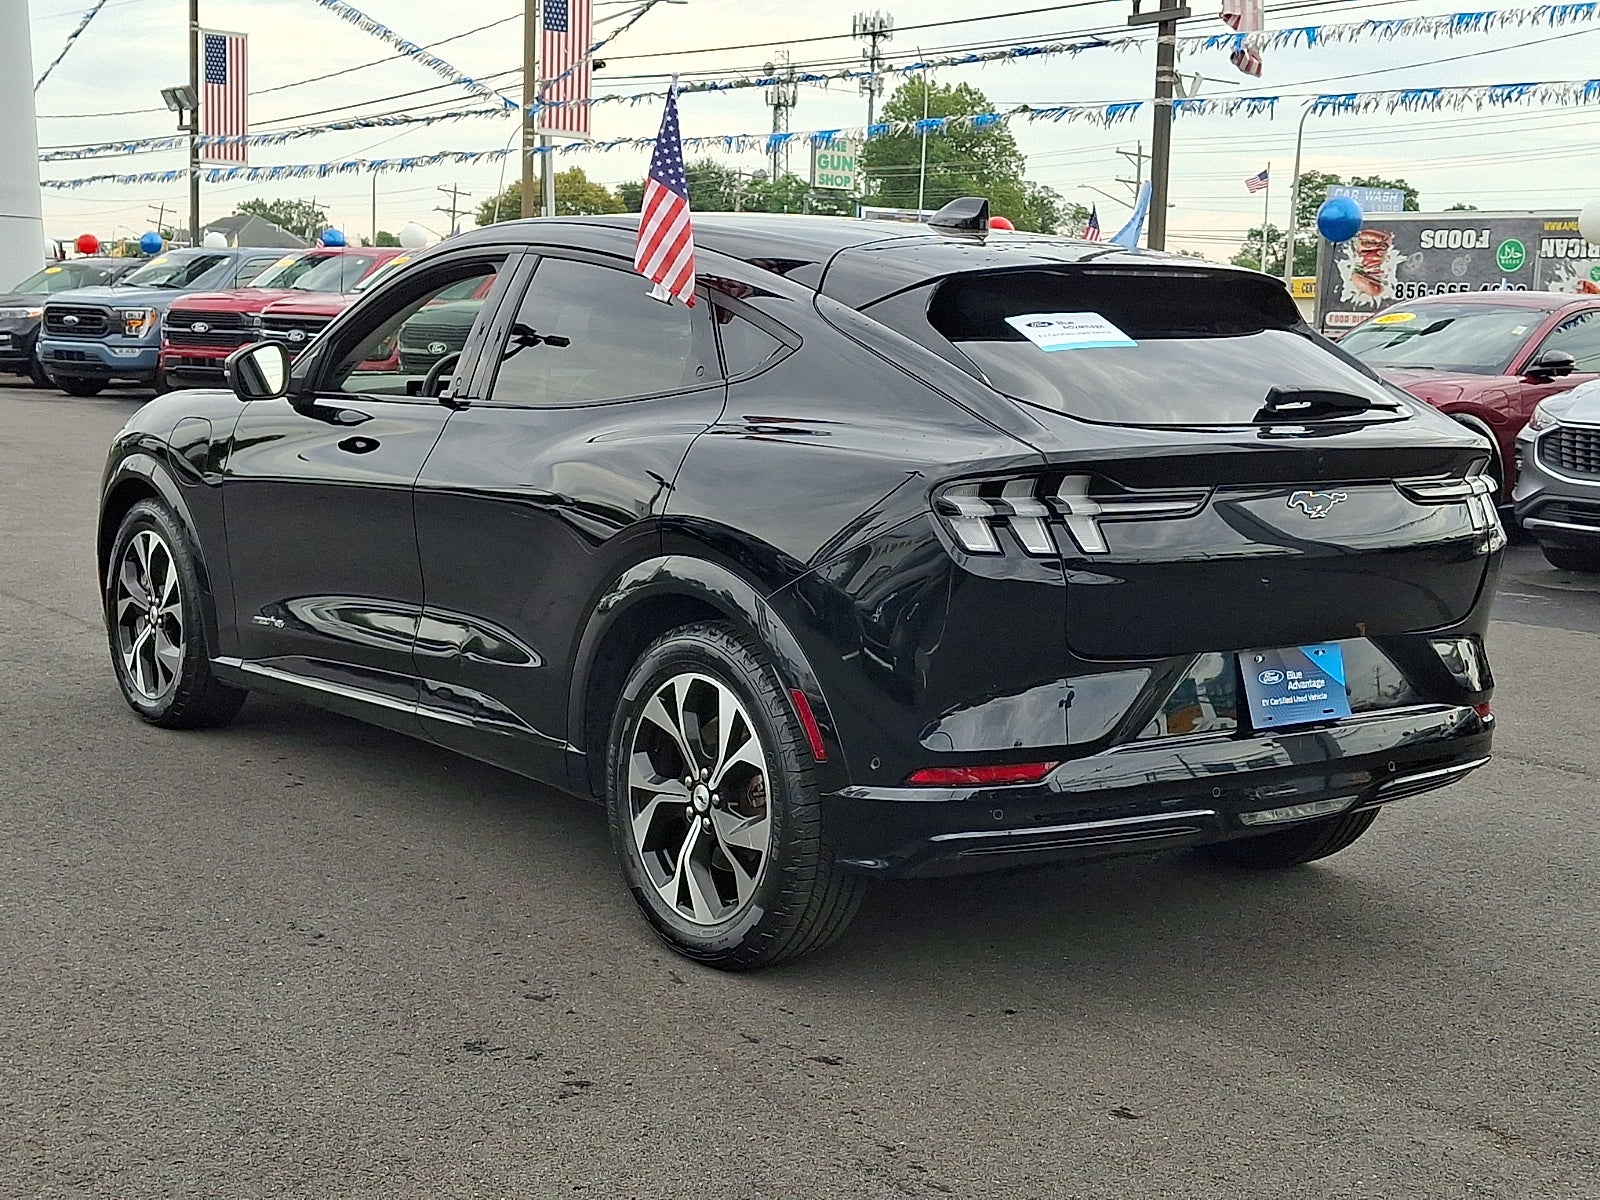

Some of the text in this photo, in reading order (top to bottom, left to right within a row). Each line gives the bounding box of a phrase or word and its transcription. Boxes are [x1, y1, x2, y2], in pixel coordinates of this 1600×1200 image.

[827, 140, 847, 152] HE
[817, 153, 854, 171] GUN
[818, 173, 851, 187] SHOP
[1334, 188, 1398, 203] CAR WASH
[1420, 229, 1491, 249] FOODS
[1394, 282, 1527, 299] 856-6654
[1329, 314, 1349, 323] FOOD
[1262, 670, 1303, 683] Ford Blue
[1287, 679, 1325, 690] Advantage
[1261, 699, 1270, 707] EV
[1270, 695, 1293, 706] Certified
[1308, 692, 1328, 701] Vehicle
